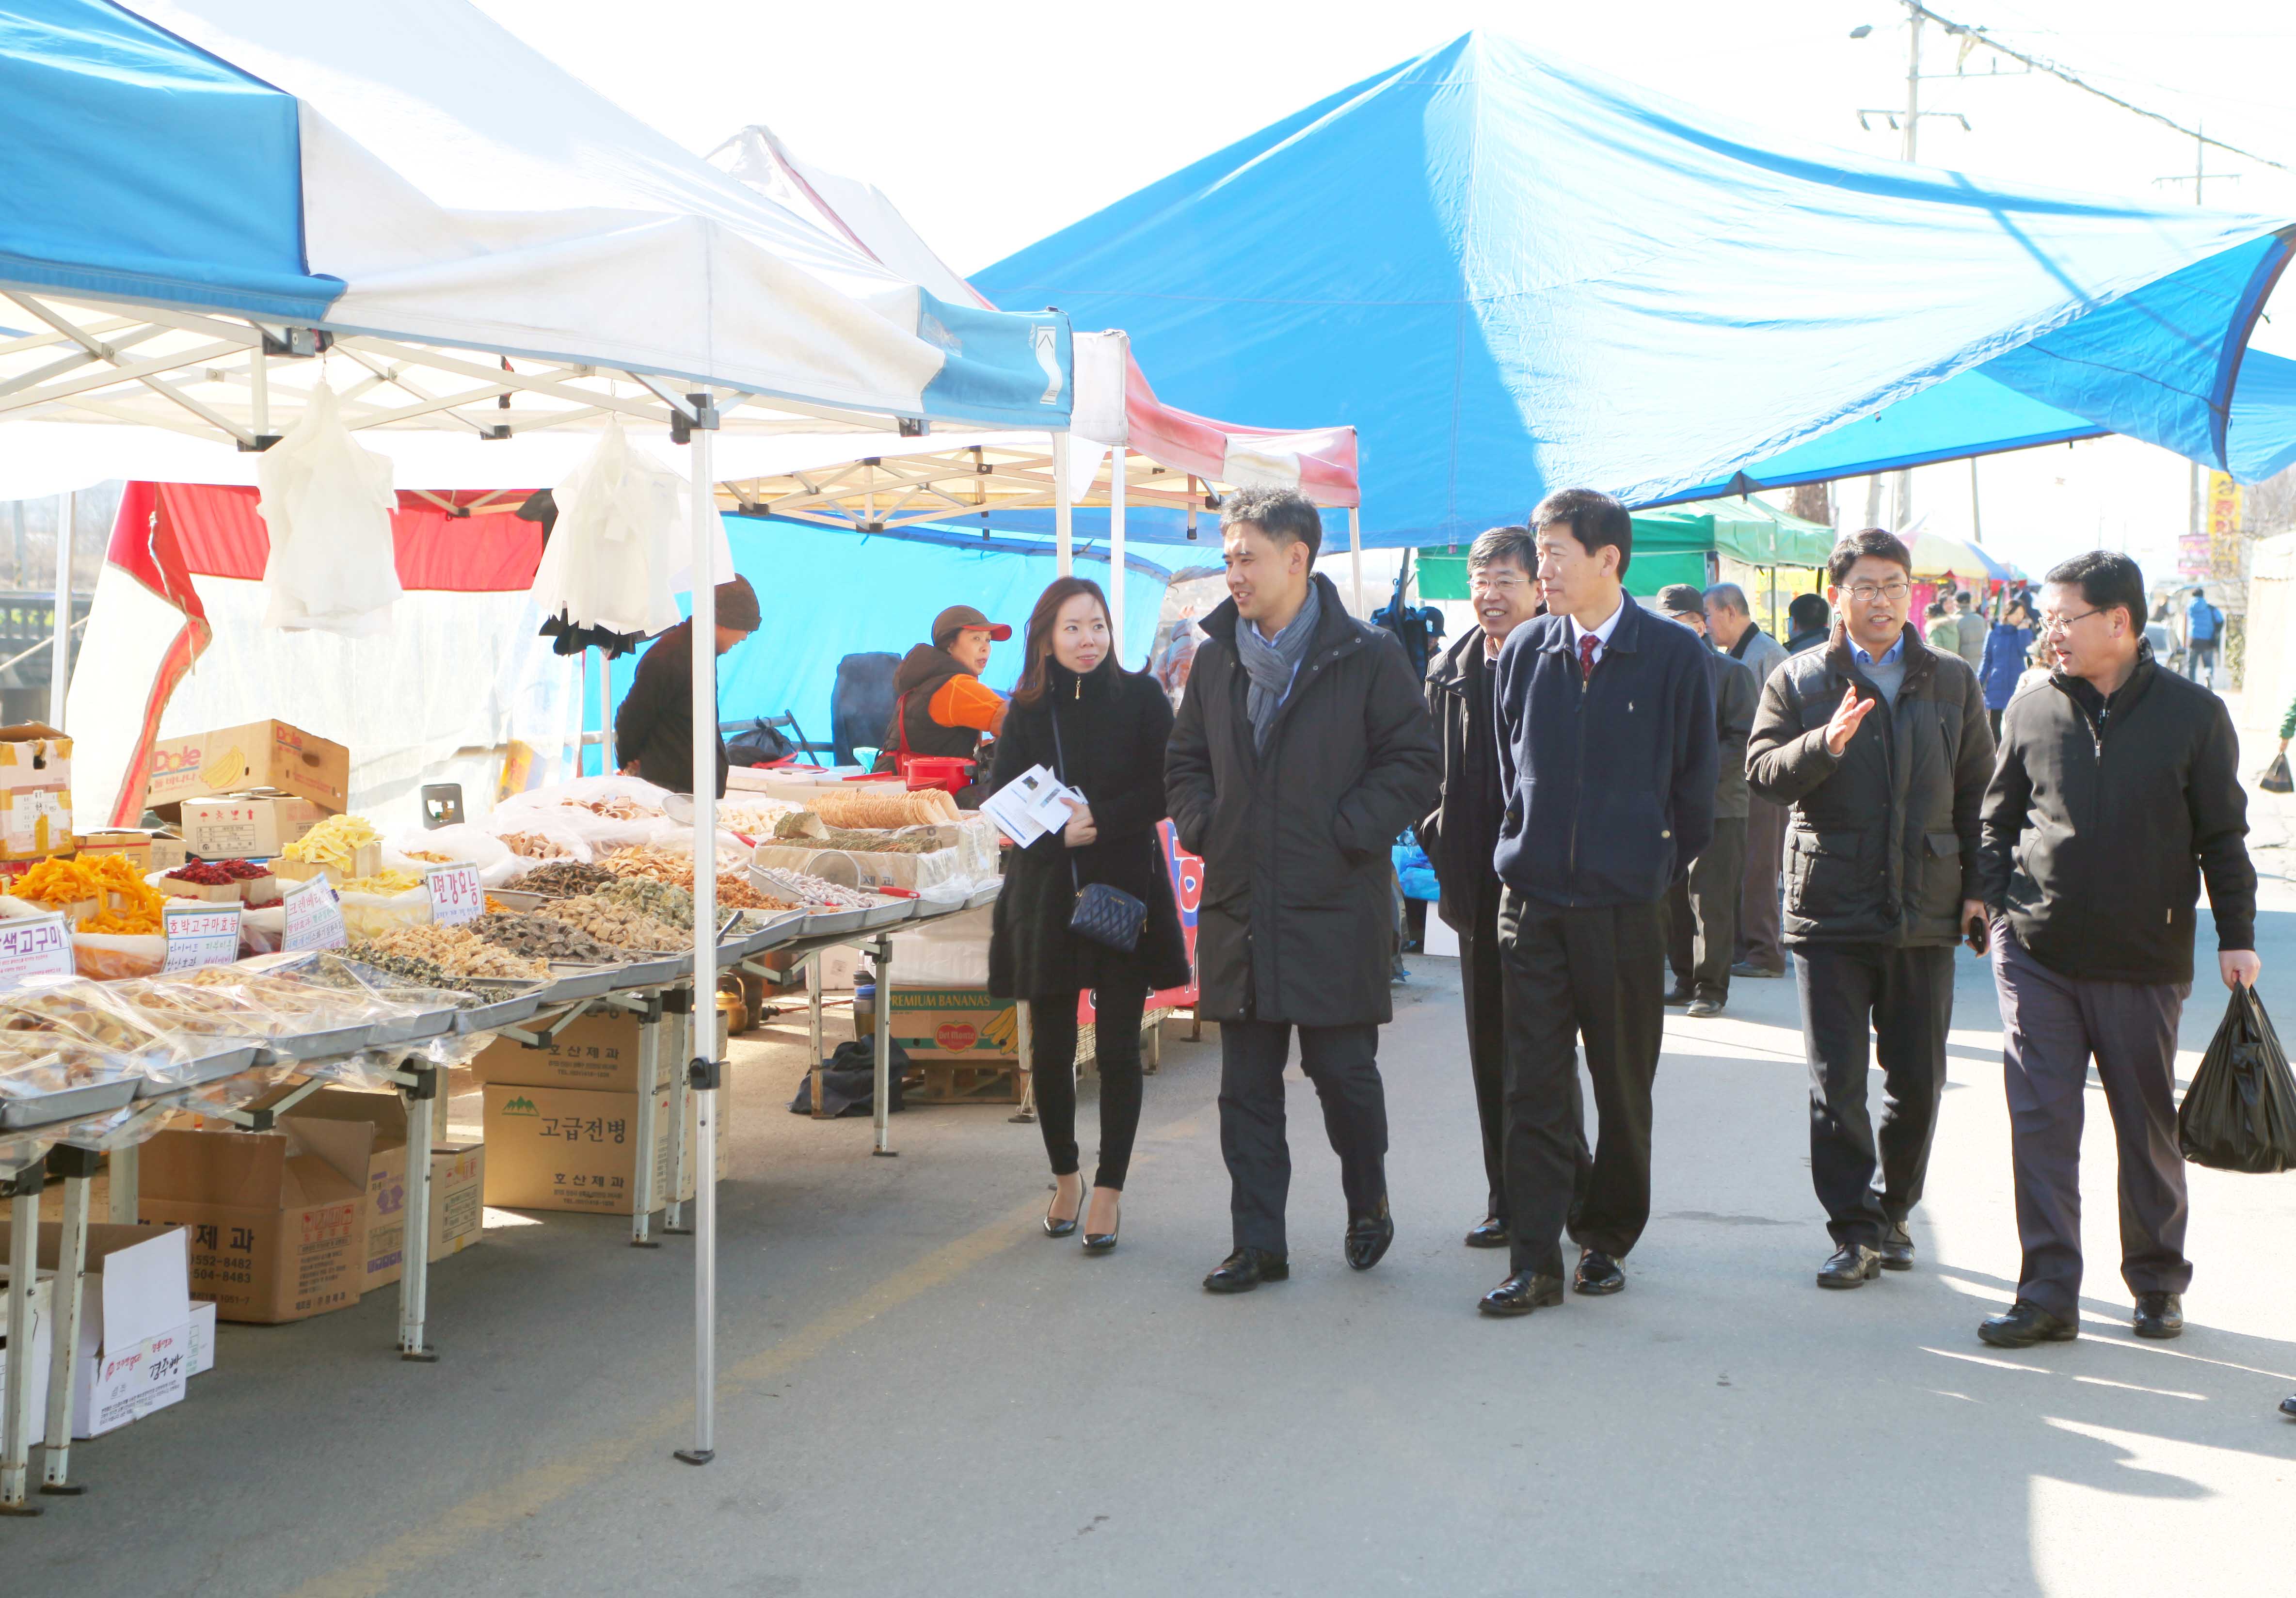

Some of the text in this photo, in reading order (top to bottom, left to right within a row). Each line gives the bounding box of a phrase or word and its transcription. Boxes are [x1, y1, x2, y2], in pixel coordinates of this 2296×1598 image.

[153, 745, 201, 772] Dole
[166, 773, 196, 785] 바나나
[0, 926, 62, 955] 색고구마
[170, 943, 198, 952] 다이어트
[939, 994, 990, 1007] BANANAS
[539, 1117, 625, 1144] 고급전병
[554, 1172, 624, 1189] 호산제과
[149, 1353, 184, 1381] 경주빵
